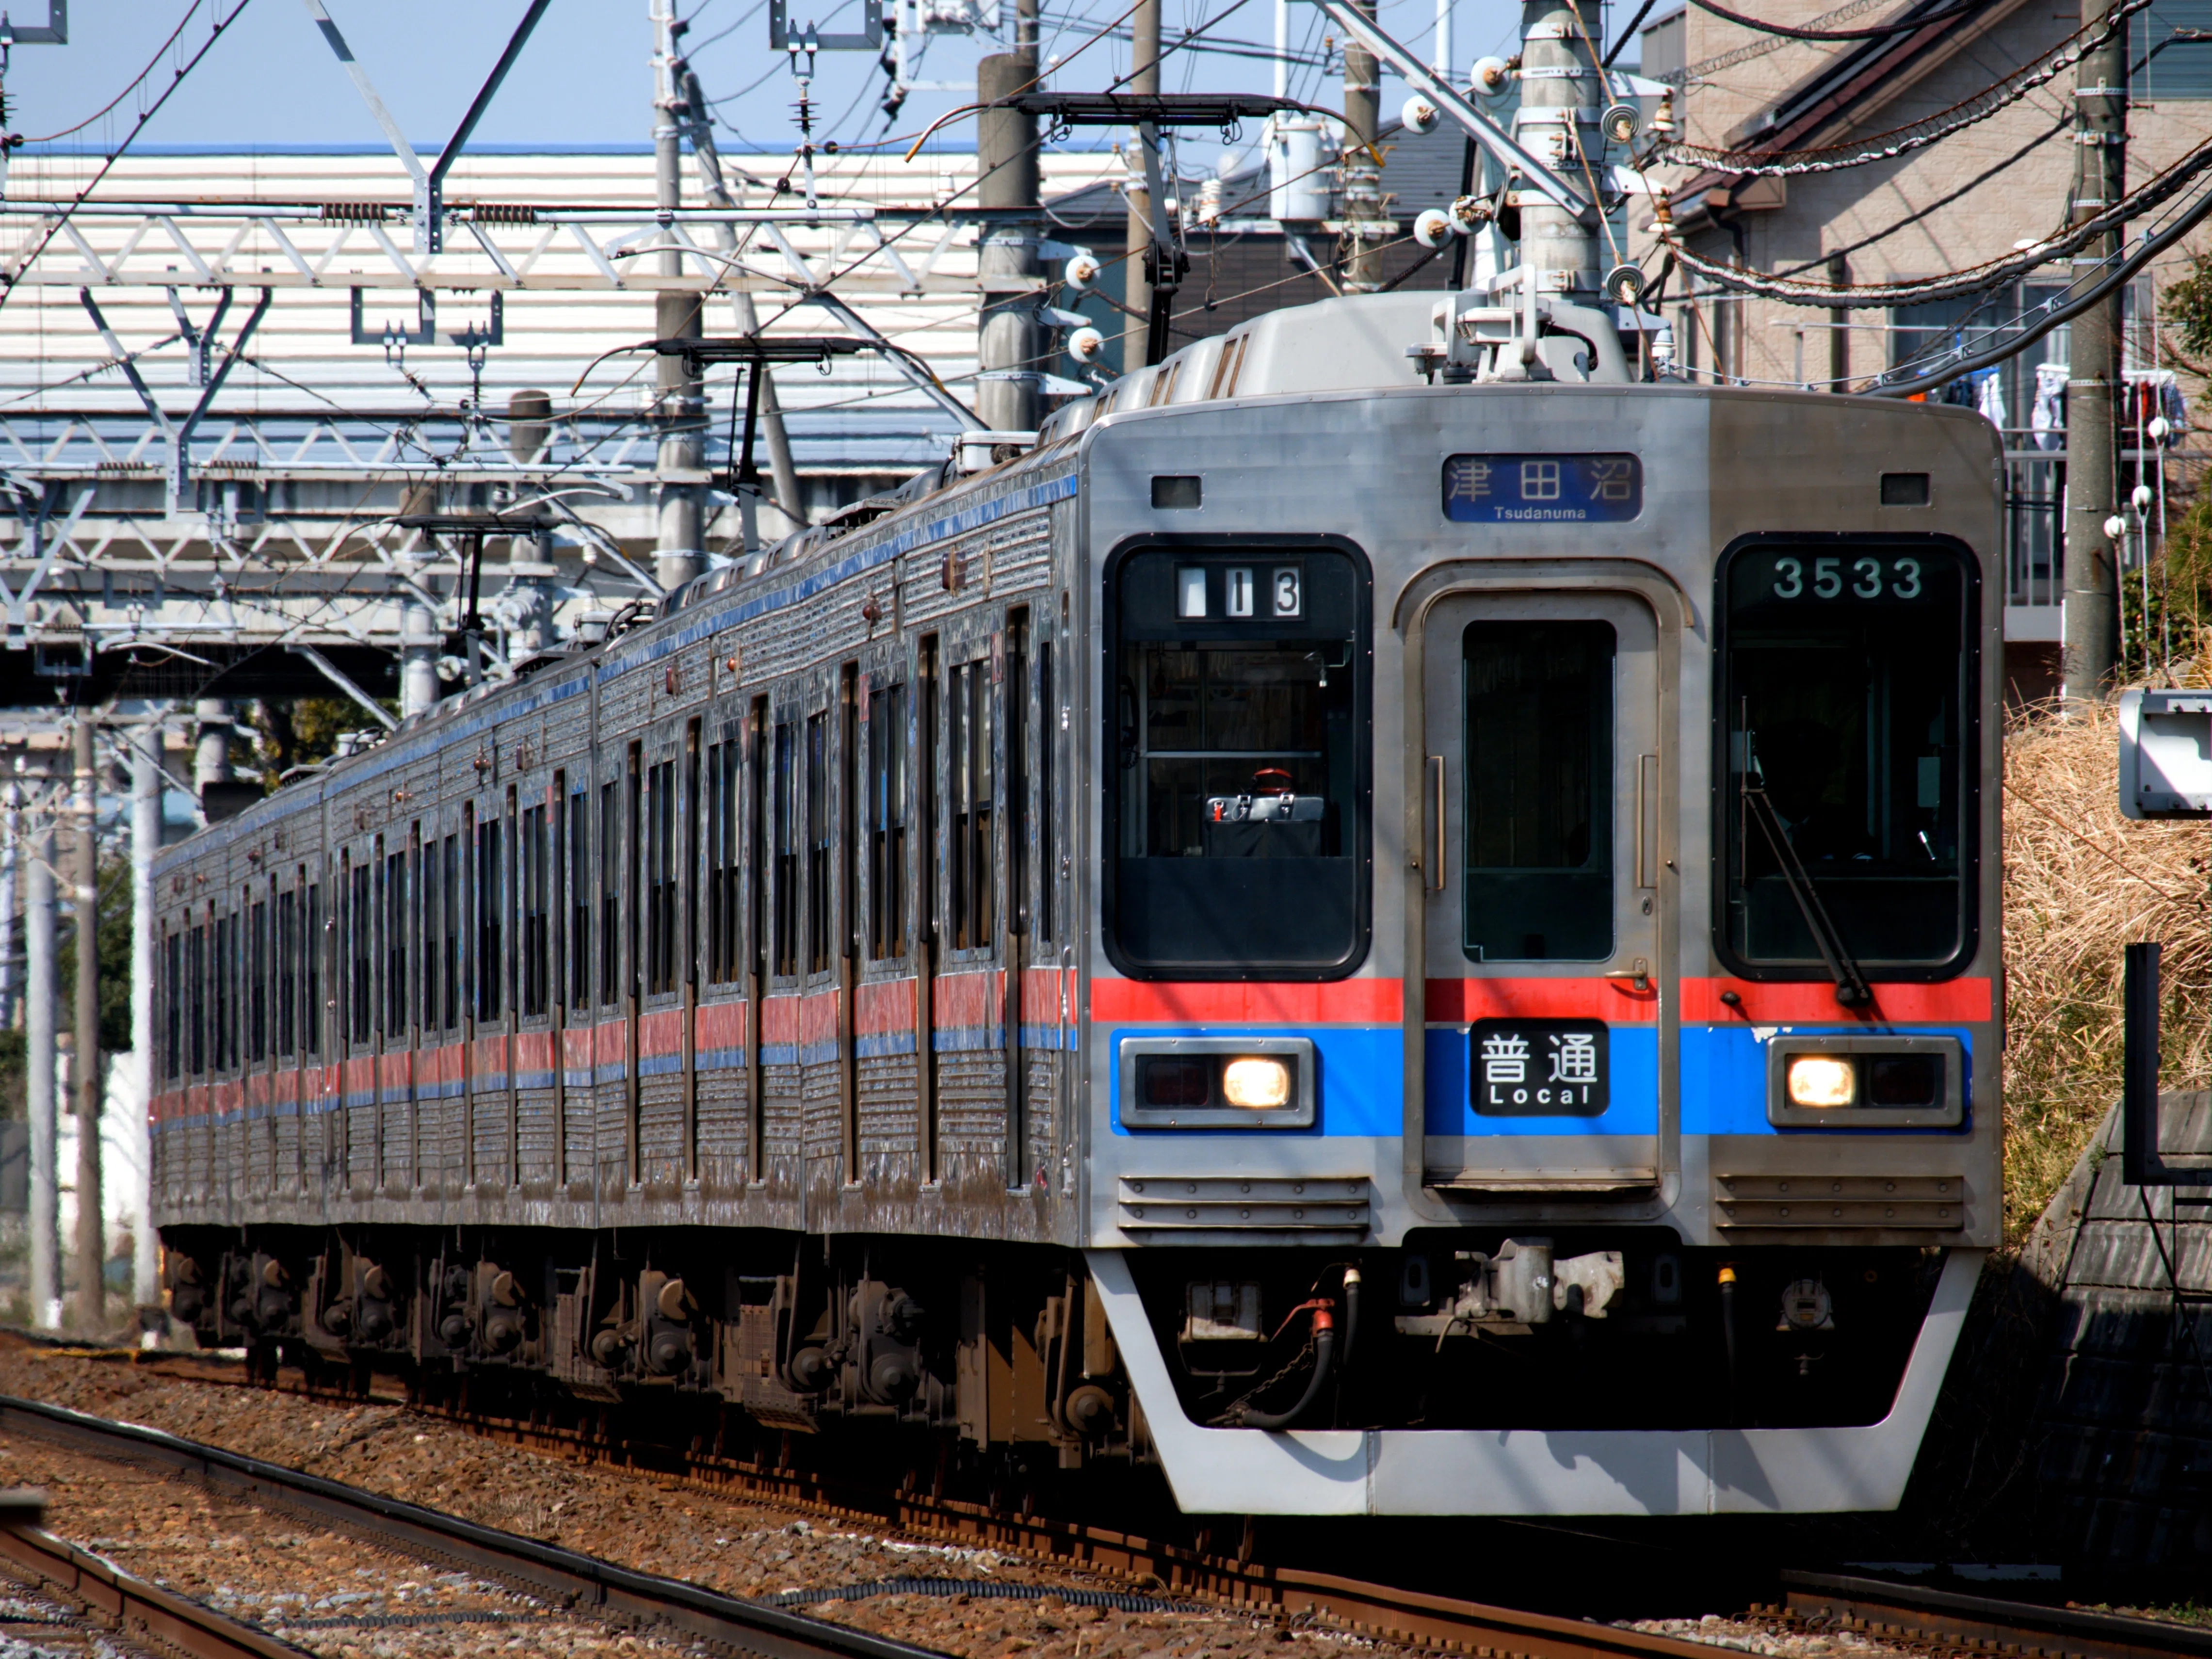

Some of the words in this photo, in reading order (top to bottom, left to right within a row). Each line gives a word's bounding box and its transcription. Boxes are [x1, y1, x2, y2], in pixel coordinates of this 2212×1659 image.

[1449, 459, 1631, 502] 津田沼
[1494, 507, 1586, 519] Tsudanuma
[1774, 557, 1921, 598] 3533
[1481, 1034, 1597, 1082] 普通
[1490, 1085, 1587, 1104] Local
